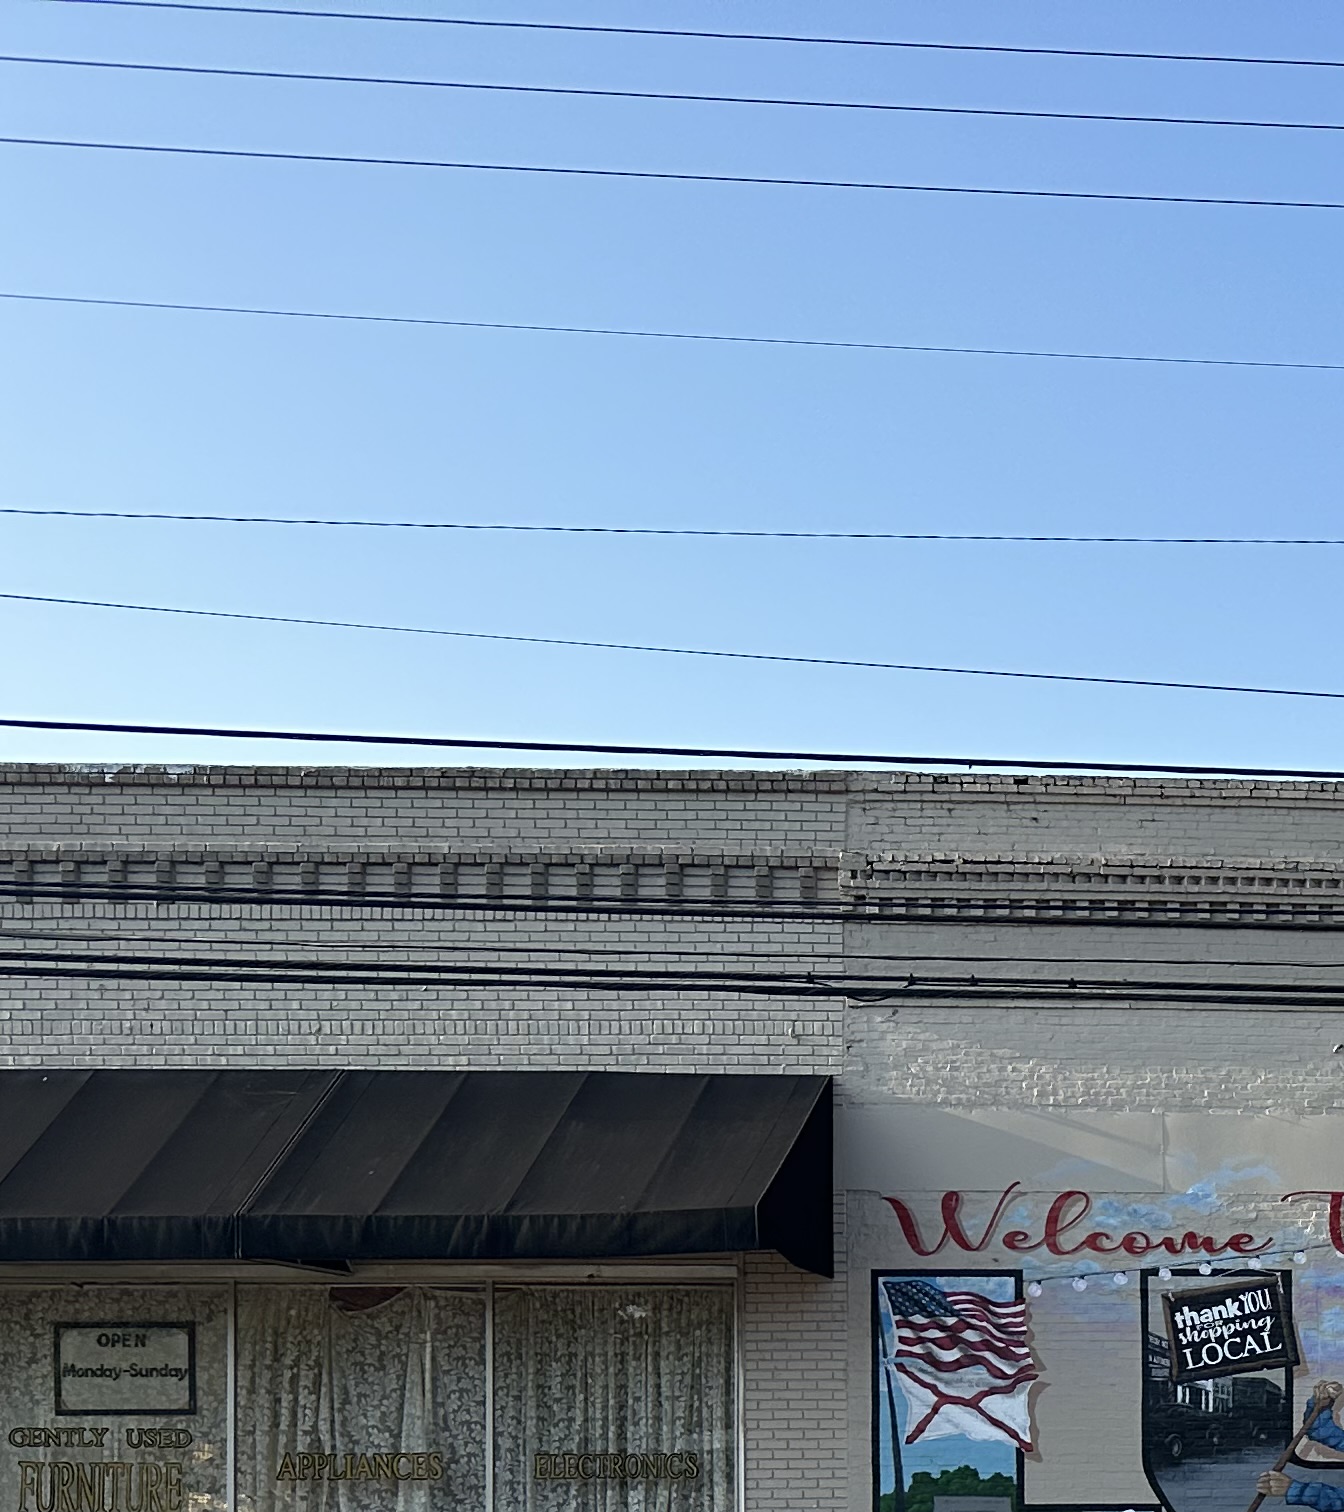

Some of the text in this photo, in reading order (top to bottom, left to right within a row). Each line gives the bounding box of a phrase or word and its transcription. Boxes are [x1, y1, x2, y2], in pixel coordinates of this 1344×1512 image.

[881, 1181, 1272, 1257] Welcome
[97, 1333, 147, 1348] OPEN
[1178, 1315, 1275, 1345] shopping
[1182, 1331, 1282, 1370] LOCAL
[8, 1427, 193, 1448] GENTLY USED
[277, 1452, 444, 1481] APPLIANCES
[534, 1452, 699, 1480] ELECTRONICS
